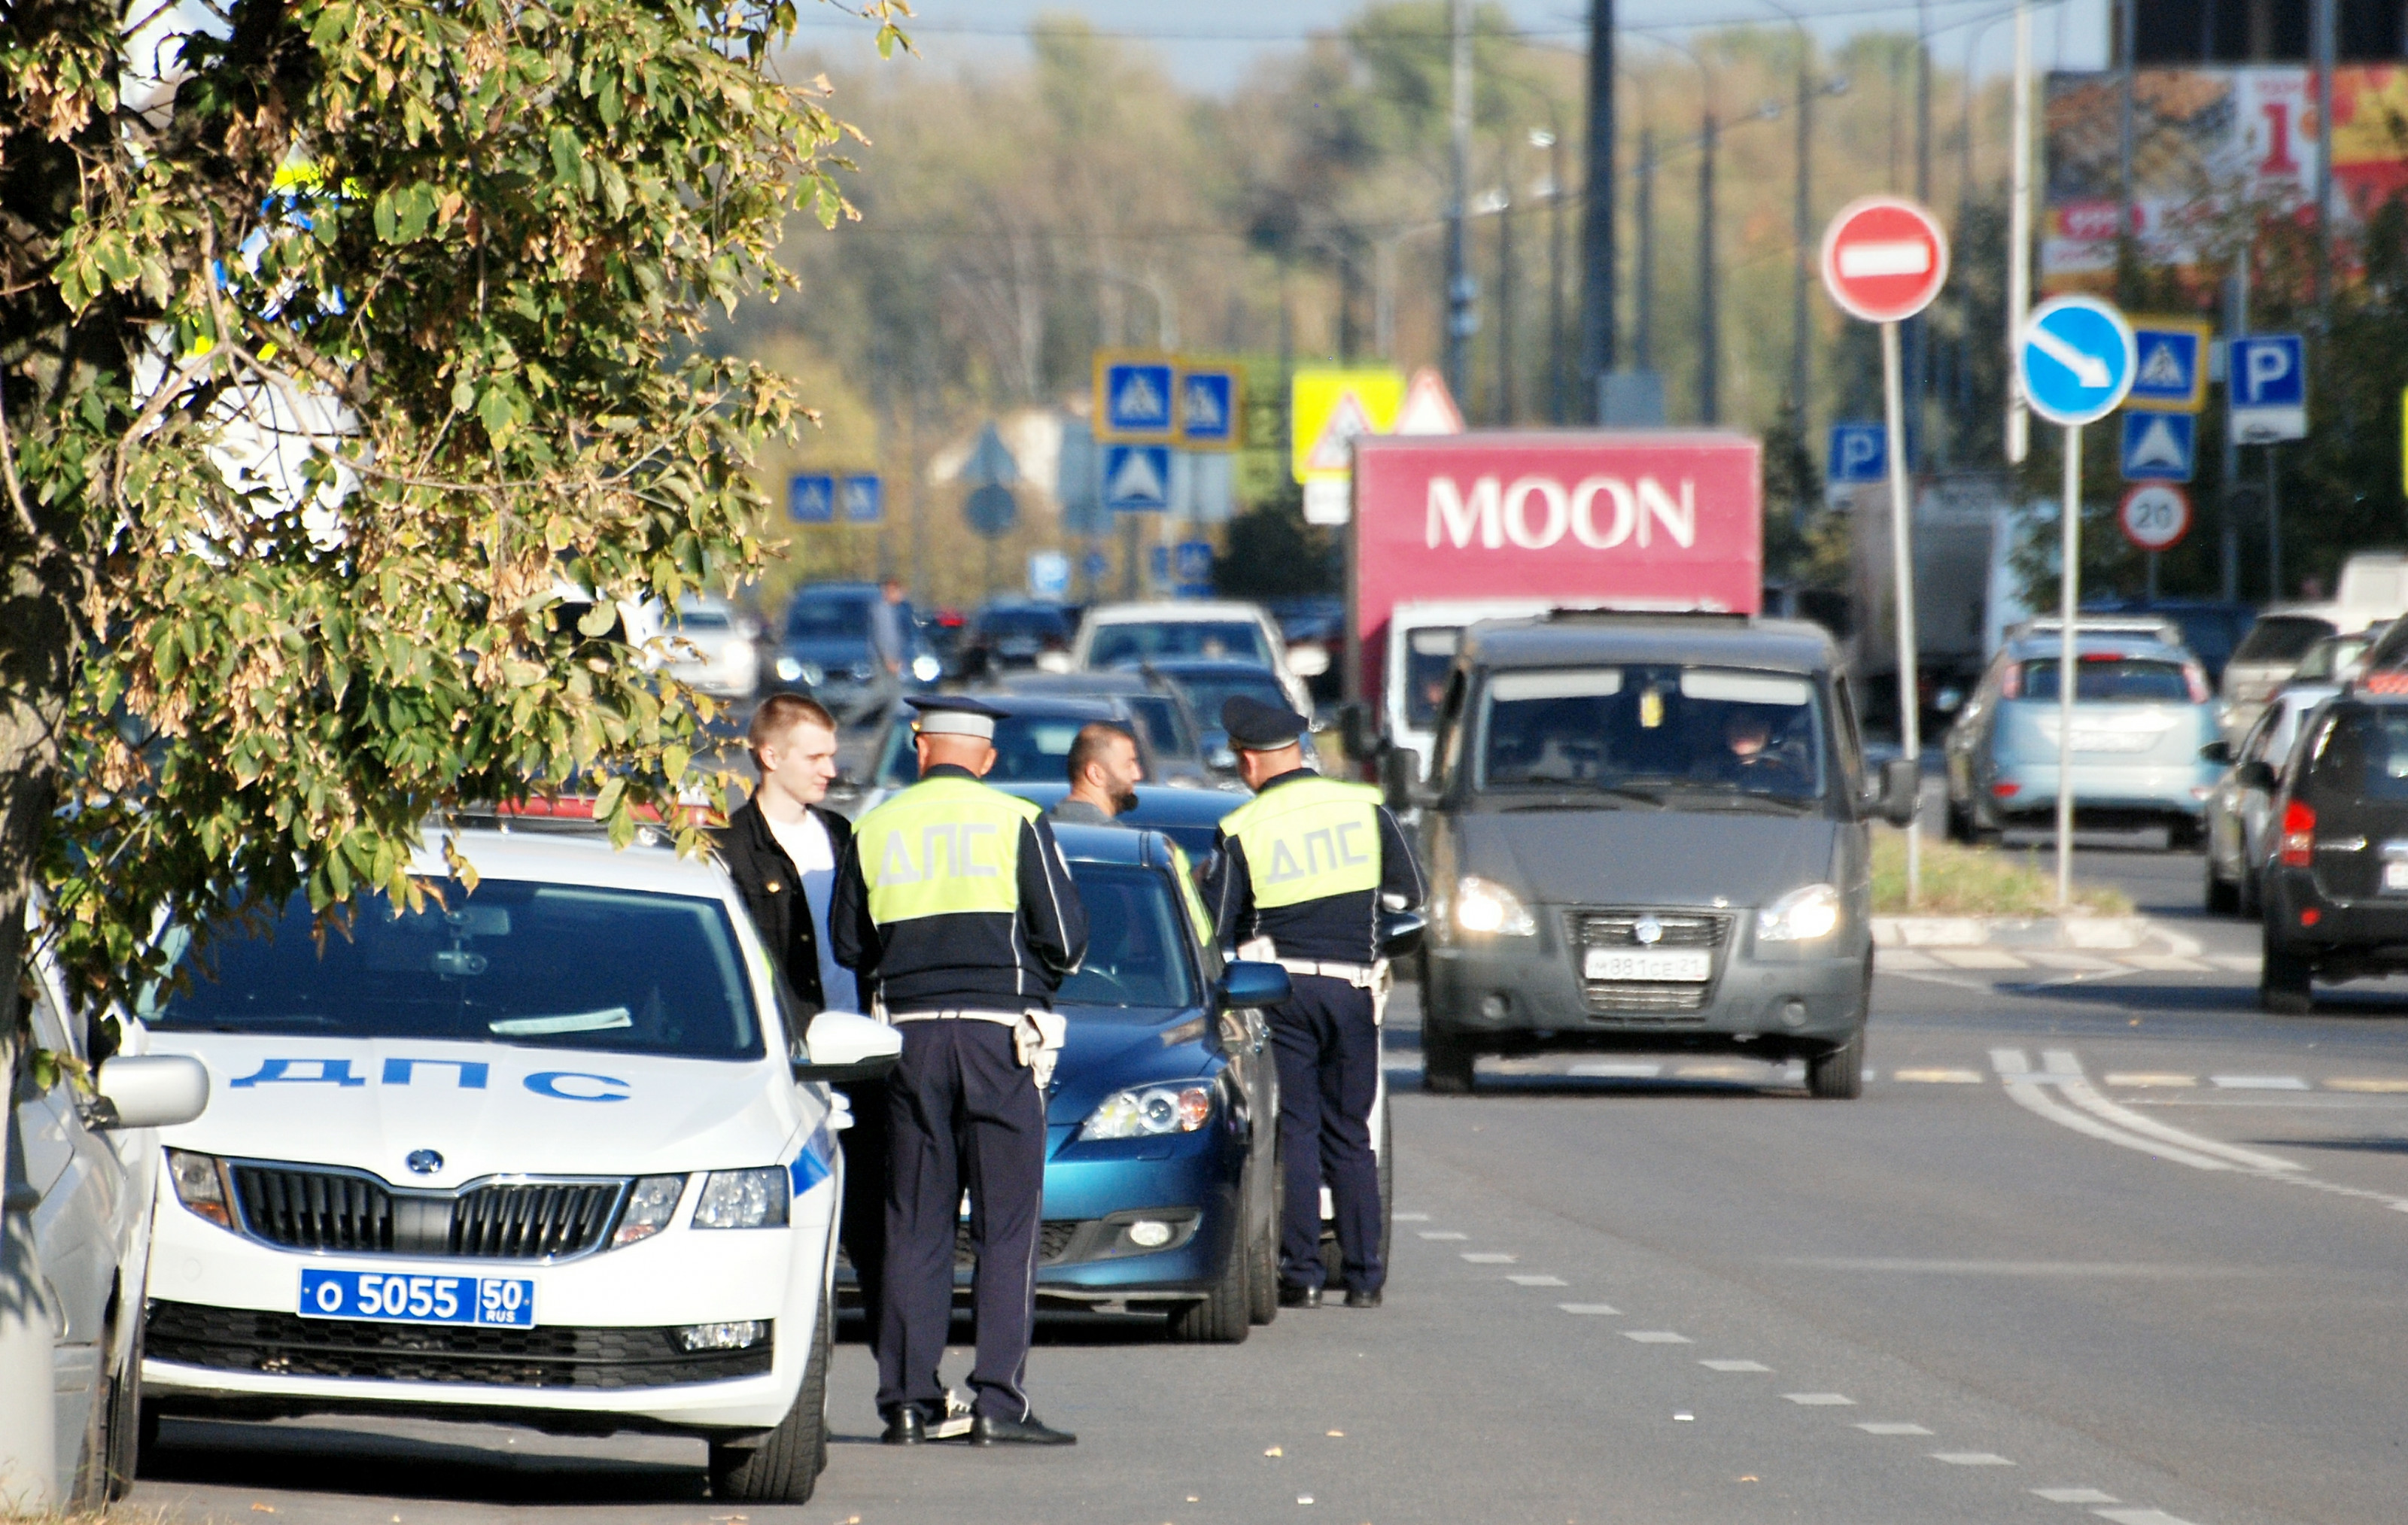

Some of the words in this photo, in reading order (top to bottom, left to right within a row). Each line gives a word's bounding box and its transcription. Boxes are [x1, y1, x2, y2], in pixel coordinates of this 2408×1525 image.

[2247, 346, 2289, 402] P
[1425, 474, 1696, 550] MOON
[2136, 503, 2173, 530] 20
[877, 824, 997, 887] ДПС
[1266, 821, 1369, 885] ДПС
[229, 1058, 632, 1103] ДПС
[357, 1274, 458, 1318] 5055
[482, 1280, 522, 1310] 50
[485, 1310, 515, 1323] RUS
